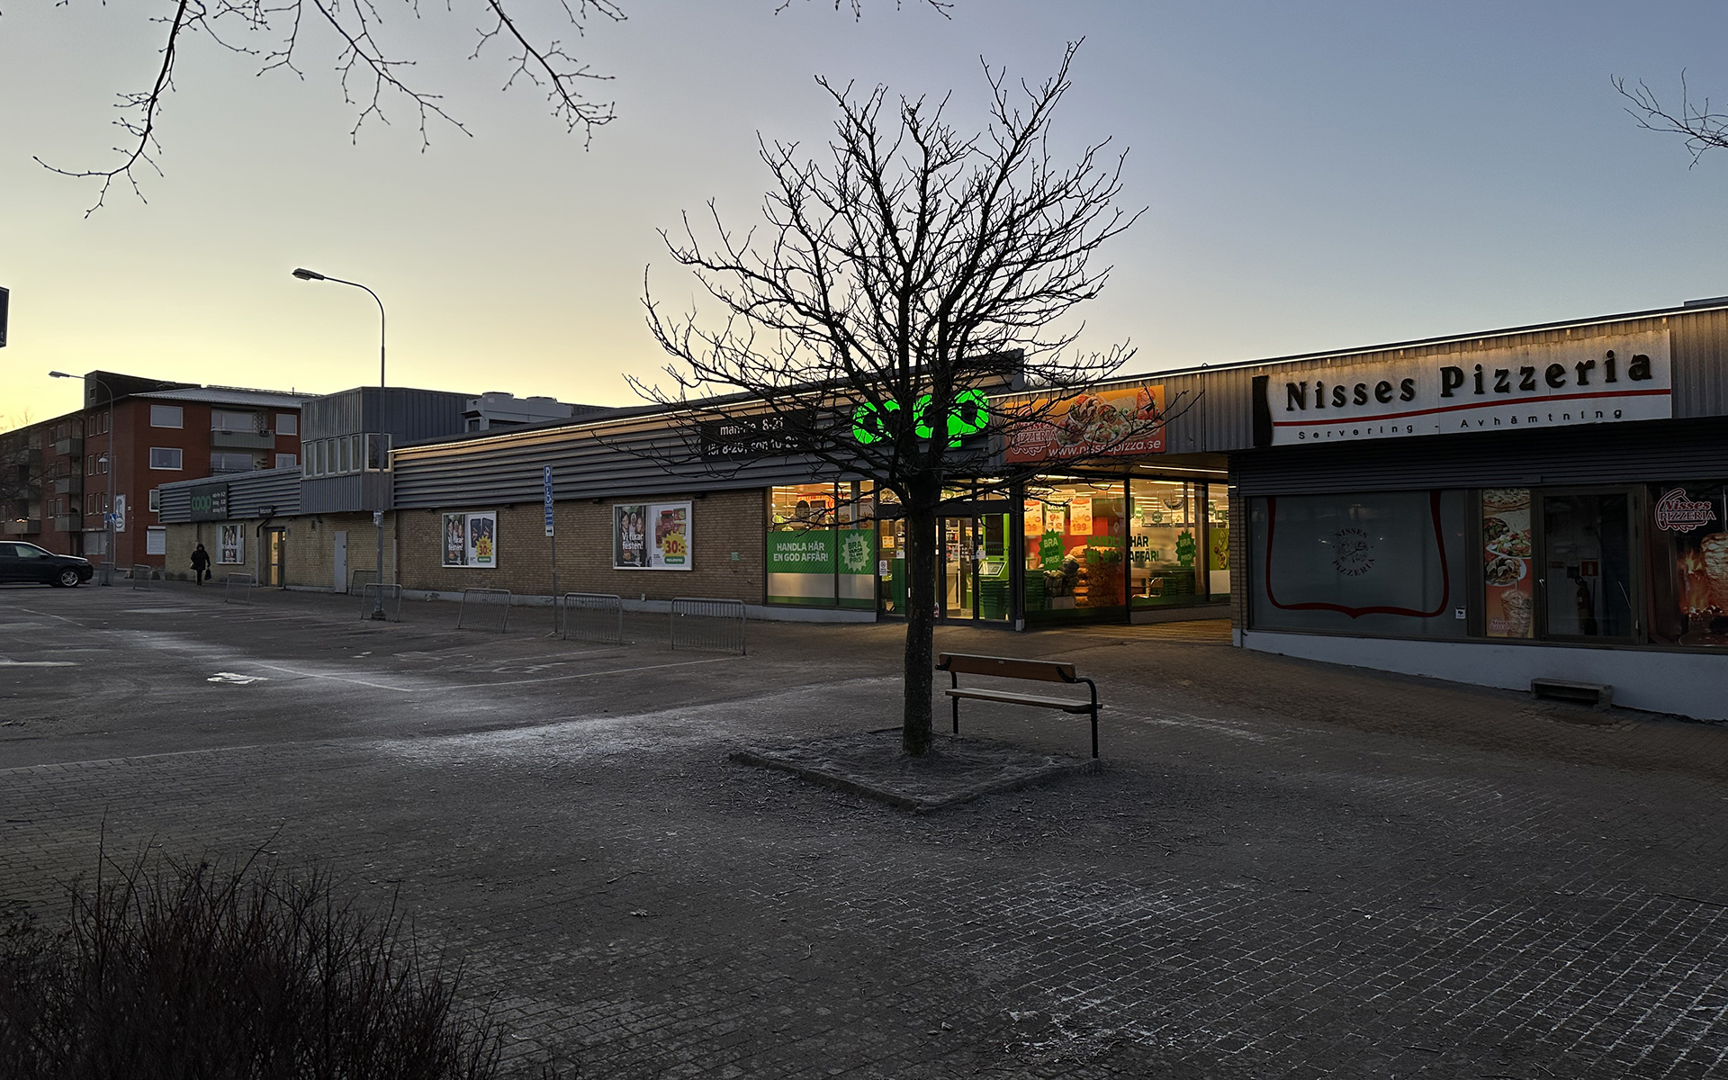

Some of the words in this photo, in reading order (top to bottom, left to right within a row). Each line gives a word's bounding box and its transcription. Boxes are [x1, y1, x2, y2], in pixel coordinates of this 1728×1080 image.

[1286, 378, 1416, 411] Nisses
[1440, 350, 1653, 398] Pizzeria
[1298, 424, 1413, 439] Servering
[1460, 409, 1622, 428] Avhämtning
[545, 466, 551, 483] P
[191, 495, 212, 513] coop
[1661, 499, 1712, 511] Nisses
[1659, 510, 1717, 521] PIZZERIA
[1334, 528, 1369, 539] NISSES
[848, 541, 862, 549] BRA
[1043, 537, 1059, 548] BRA
[1086, 535, 1125, 547] HANDLA
[1129, 533, 1149, 547] HÄR
[1179, 538, 1192, 547] BRA
[776, 542, 806, 551] HANDLA
[808, 541, 825, 551] HÄR
[773, 554, 784, 562] EN
[784, 553, 800, 562] GOD
[801, 552, 829, 562] AFFÄR!
[1045, 555, 1060, 565] PRIS!
[1129, 548, 1159, 562] AFFÄR!
[1332, 558, 1375, 576] PIZZERIA
